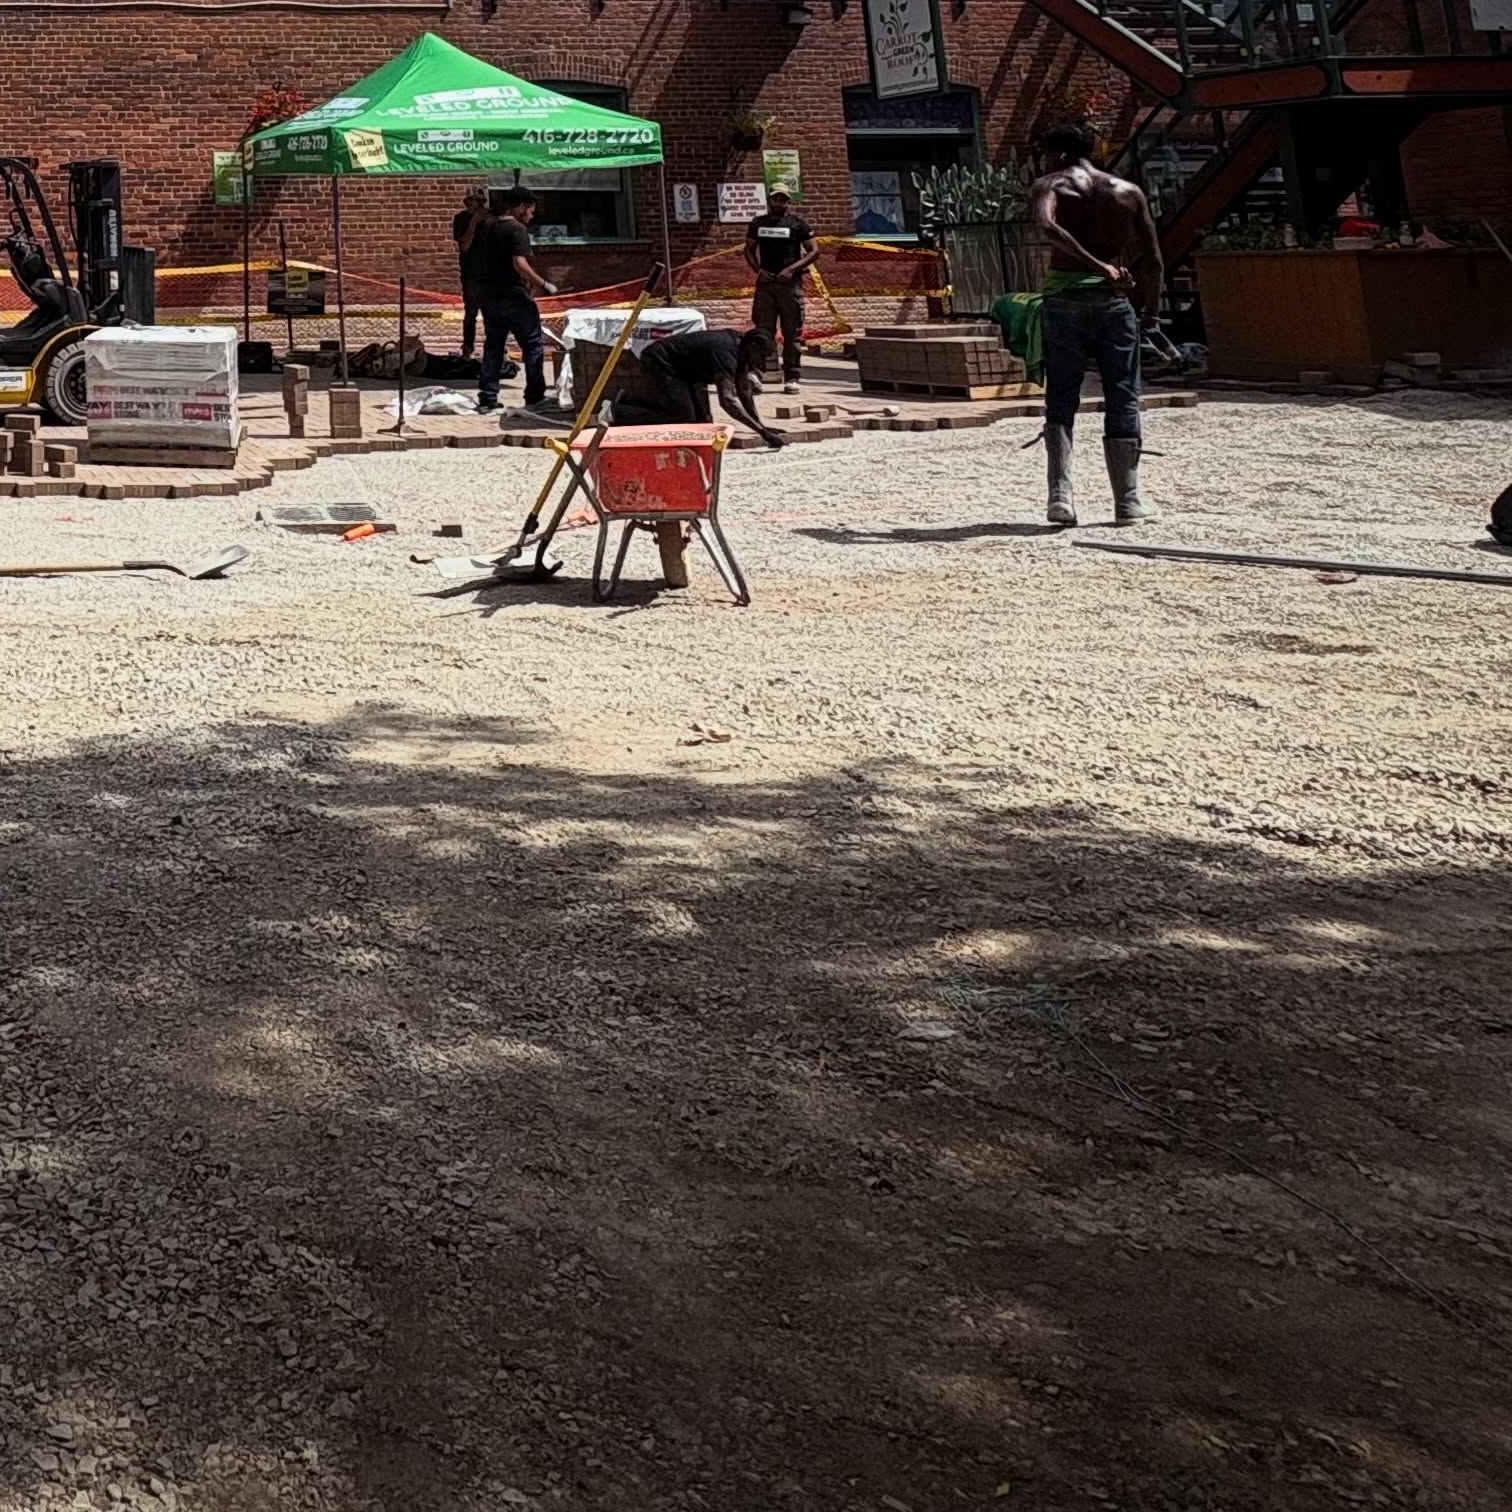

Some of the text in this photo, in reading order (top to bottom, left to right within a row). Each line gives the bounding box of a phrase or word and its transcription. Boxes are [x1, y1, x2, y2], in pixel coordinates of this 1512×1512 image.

[876, 33, 917, 56] CARROT
[376, 99, 472, 116] LEVELED
[476, 96, 573, 110] GROUND
[522, 128, 654, 144] 416-728-2720
[393, 141, 499, 154] LEVELED GROUND
[136, 401, 163, 410] WAY
